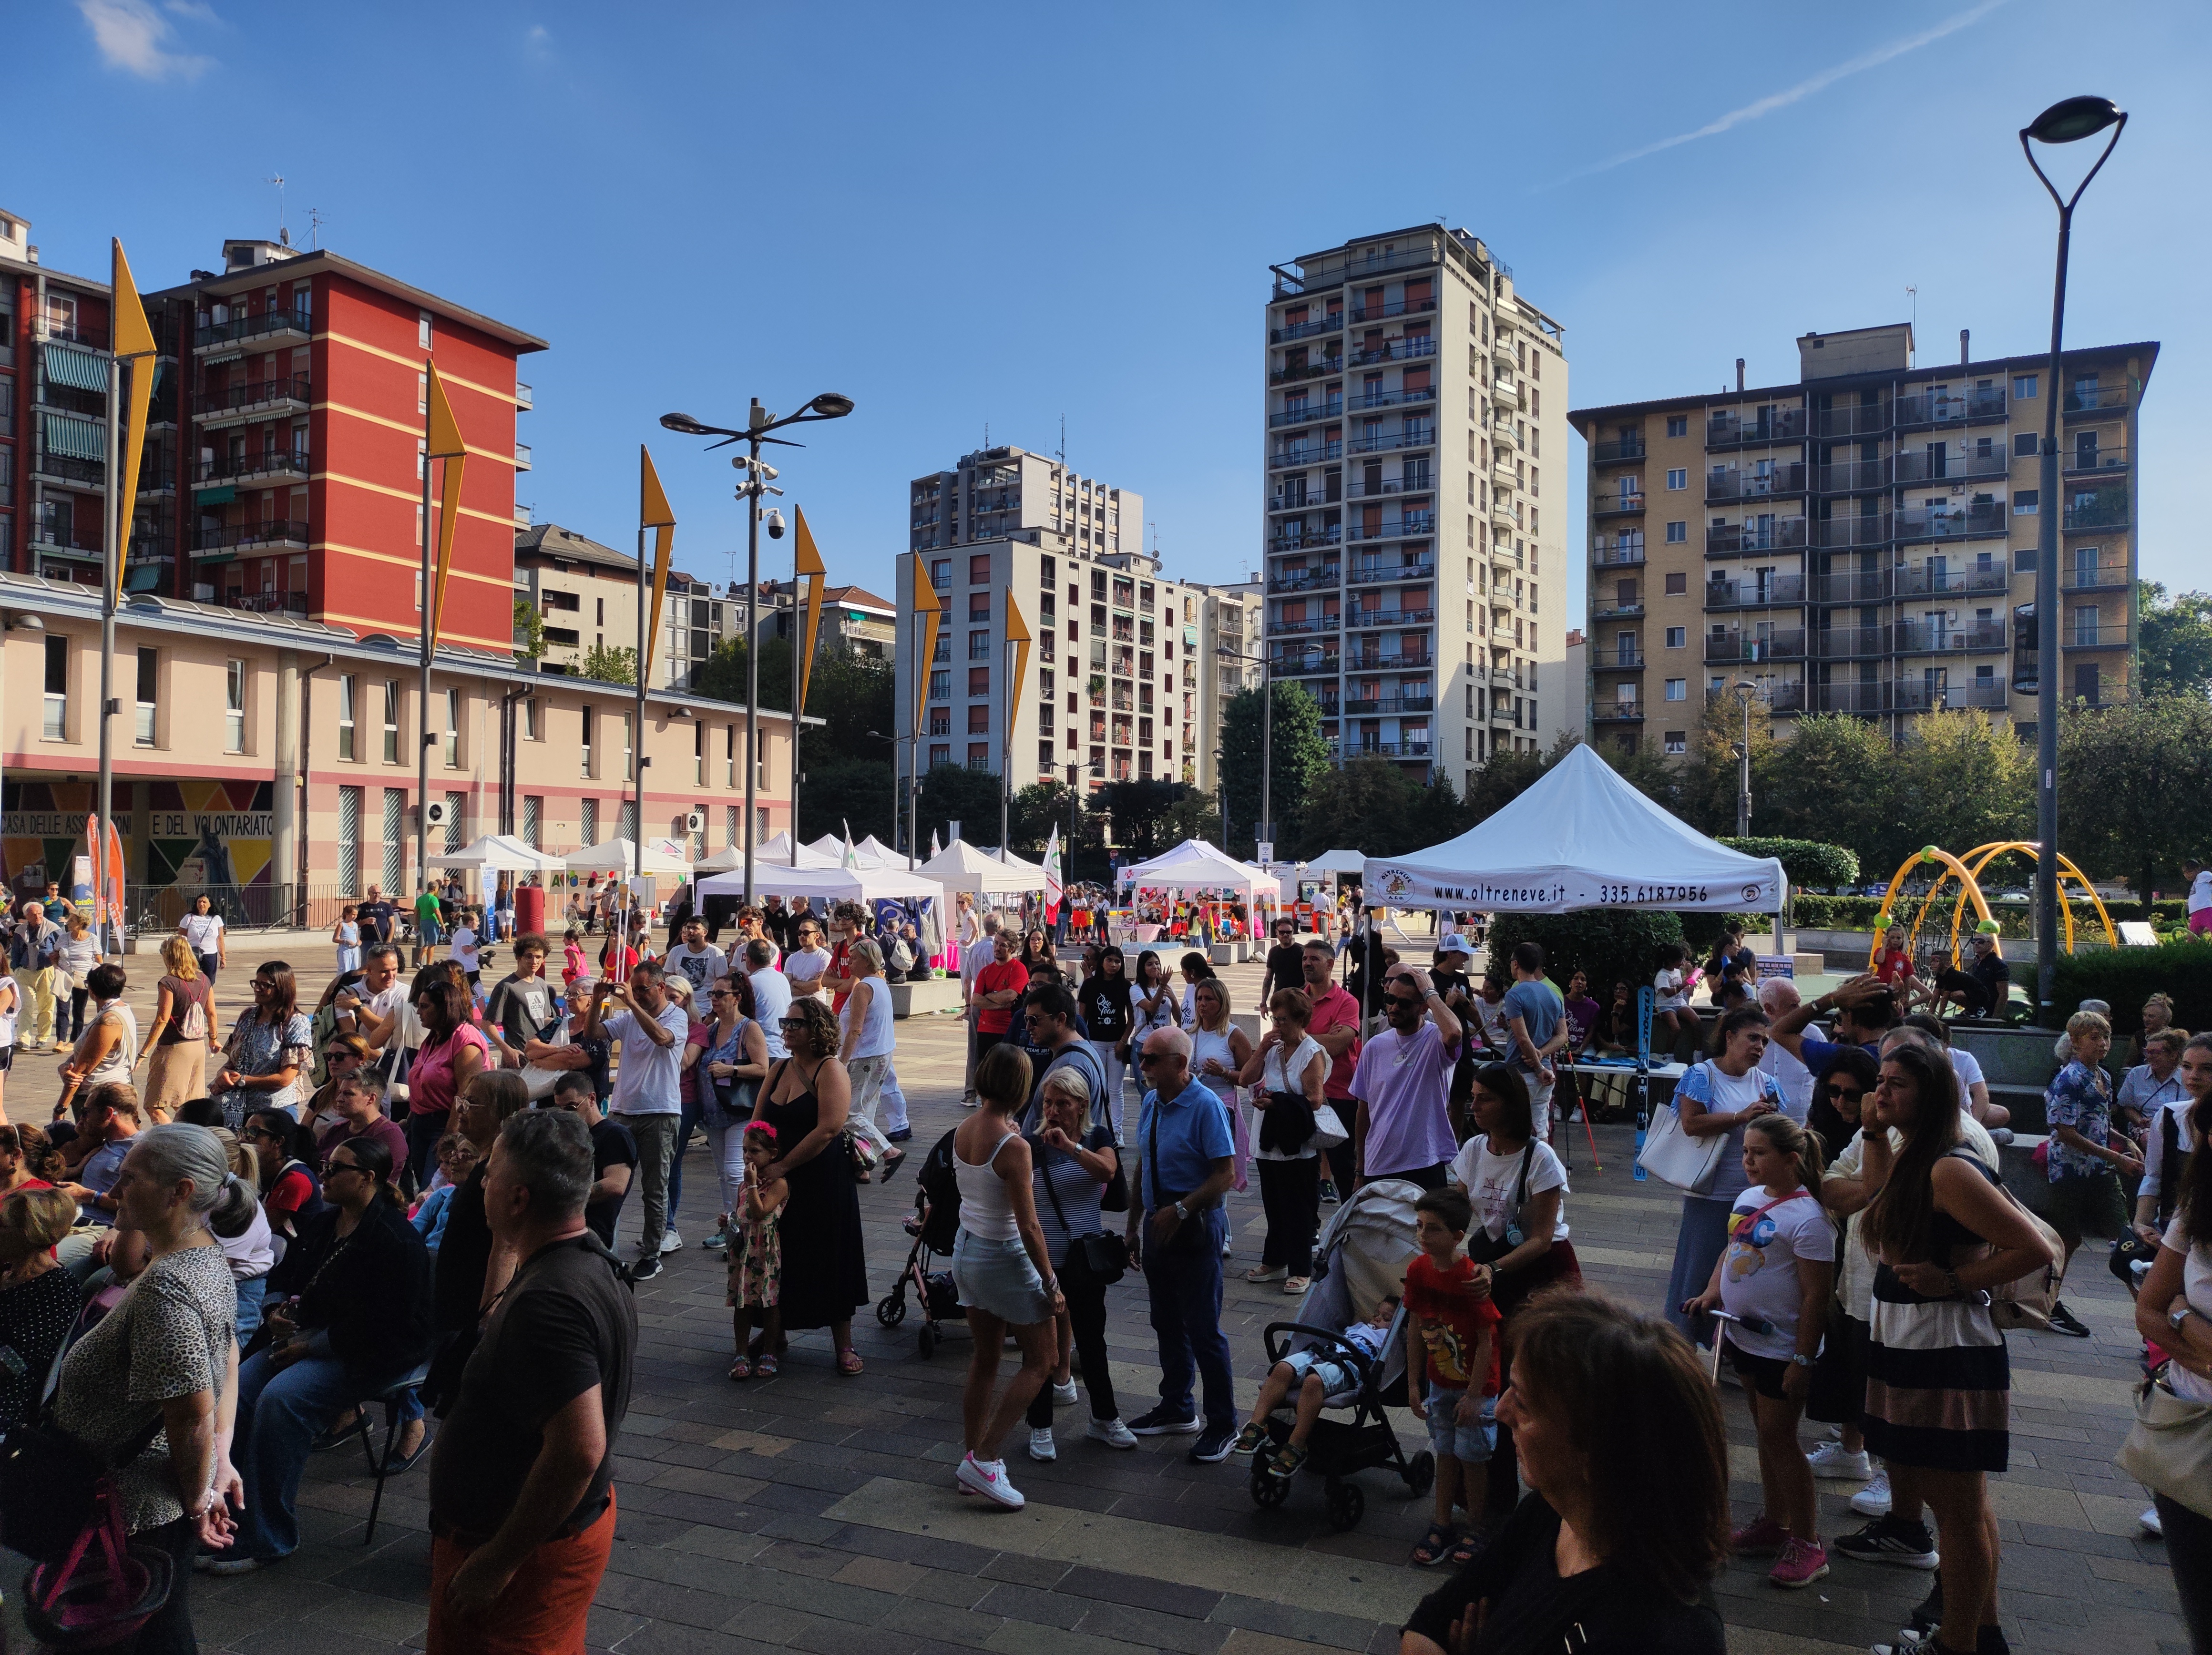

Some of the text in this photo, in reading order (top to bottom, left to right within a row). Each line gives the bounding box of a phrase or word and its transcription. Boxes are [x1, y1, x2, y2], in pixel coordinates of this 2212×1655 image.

[0, 815, 24, 834] CASA
[30, 815, 60, 834] DELLE
[153, 815, 160, 834] E
[167, 815, 187, 835] DEL
[194, 815, 272, 836] VOLONTARIATO
[1382, 869, 1412, 883] OLTRENEVE
[1434, 883, 1565, 901] www.oltreneve.it
[1600, 885, 1707, 903] 335.6187956
